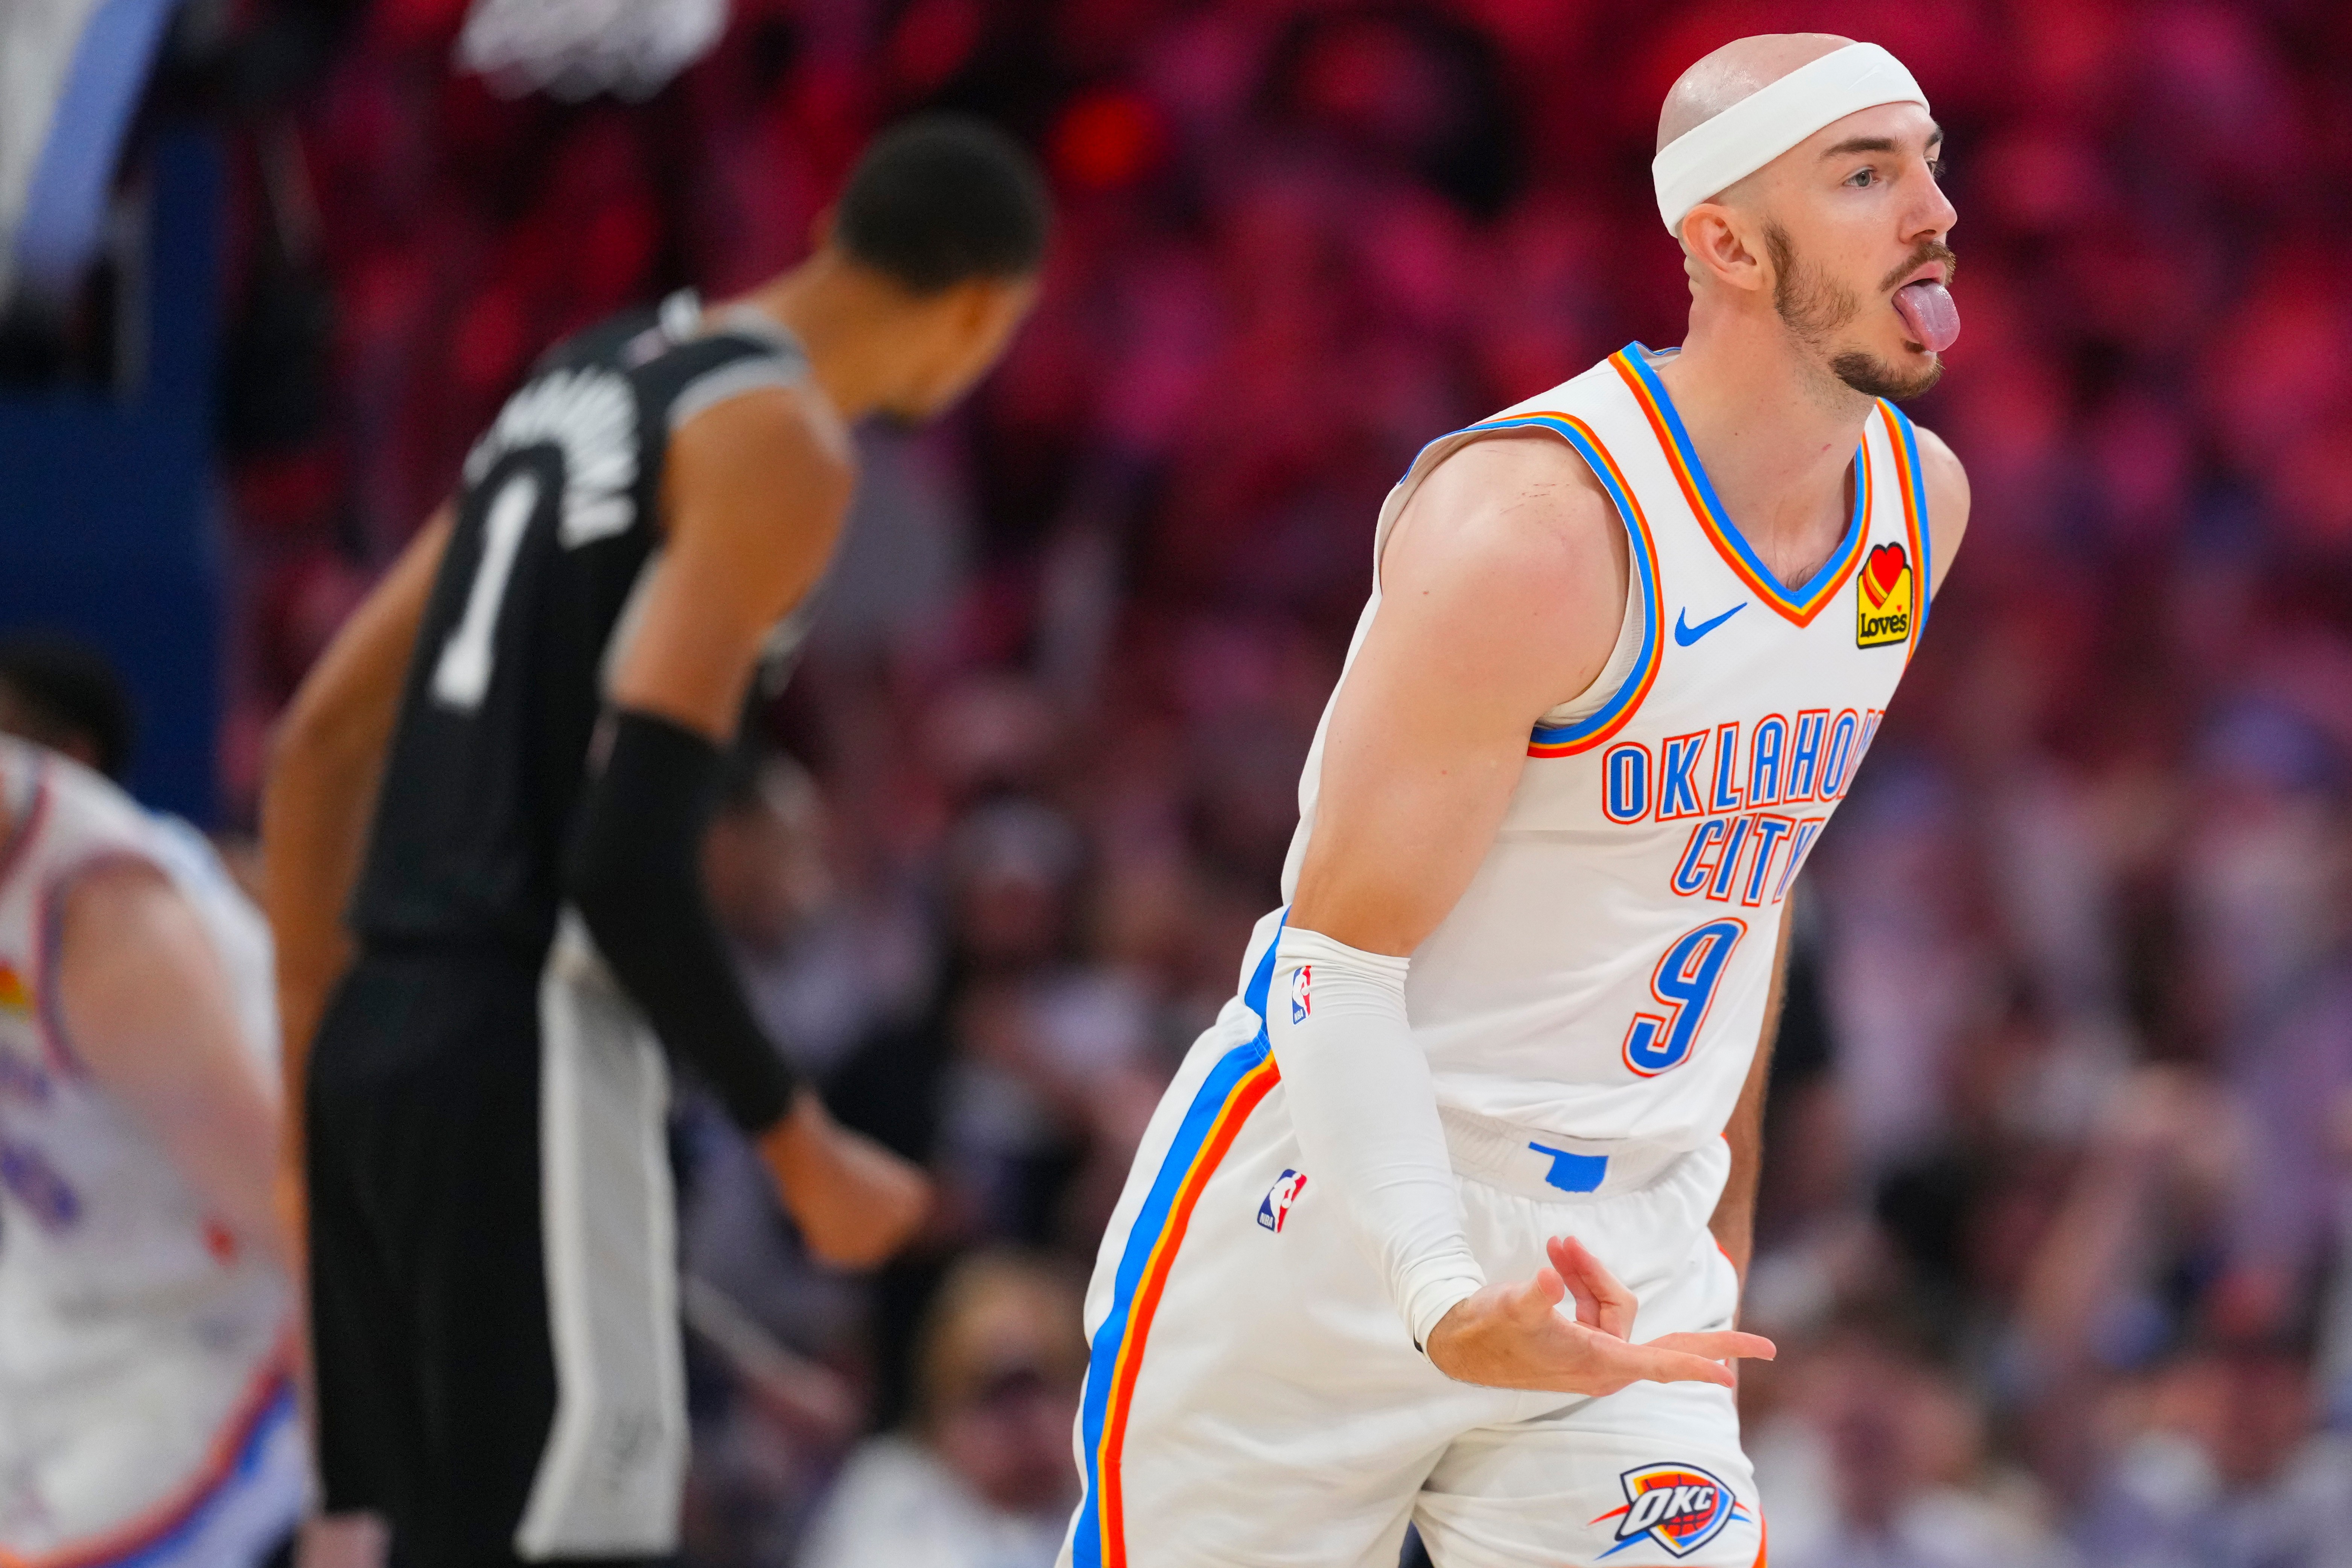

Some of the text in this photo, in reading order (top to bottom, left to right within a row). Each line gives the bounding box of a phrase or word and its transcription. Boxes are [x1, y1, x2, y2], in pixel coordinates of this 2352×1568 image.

[431, 468, 538, 717] 1
[1670, 812, 1826, 907] CITY
[1294, 1009, 1304, 1022] NBA
[1622, 917, 1748, 1078] 9
[1260, 1212, 1273, 1228] NBA
[1620, 1485, 1715, 1536] OKC
